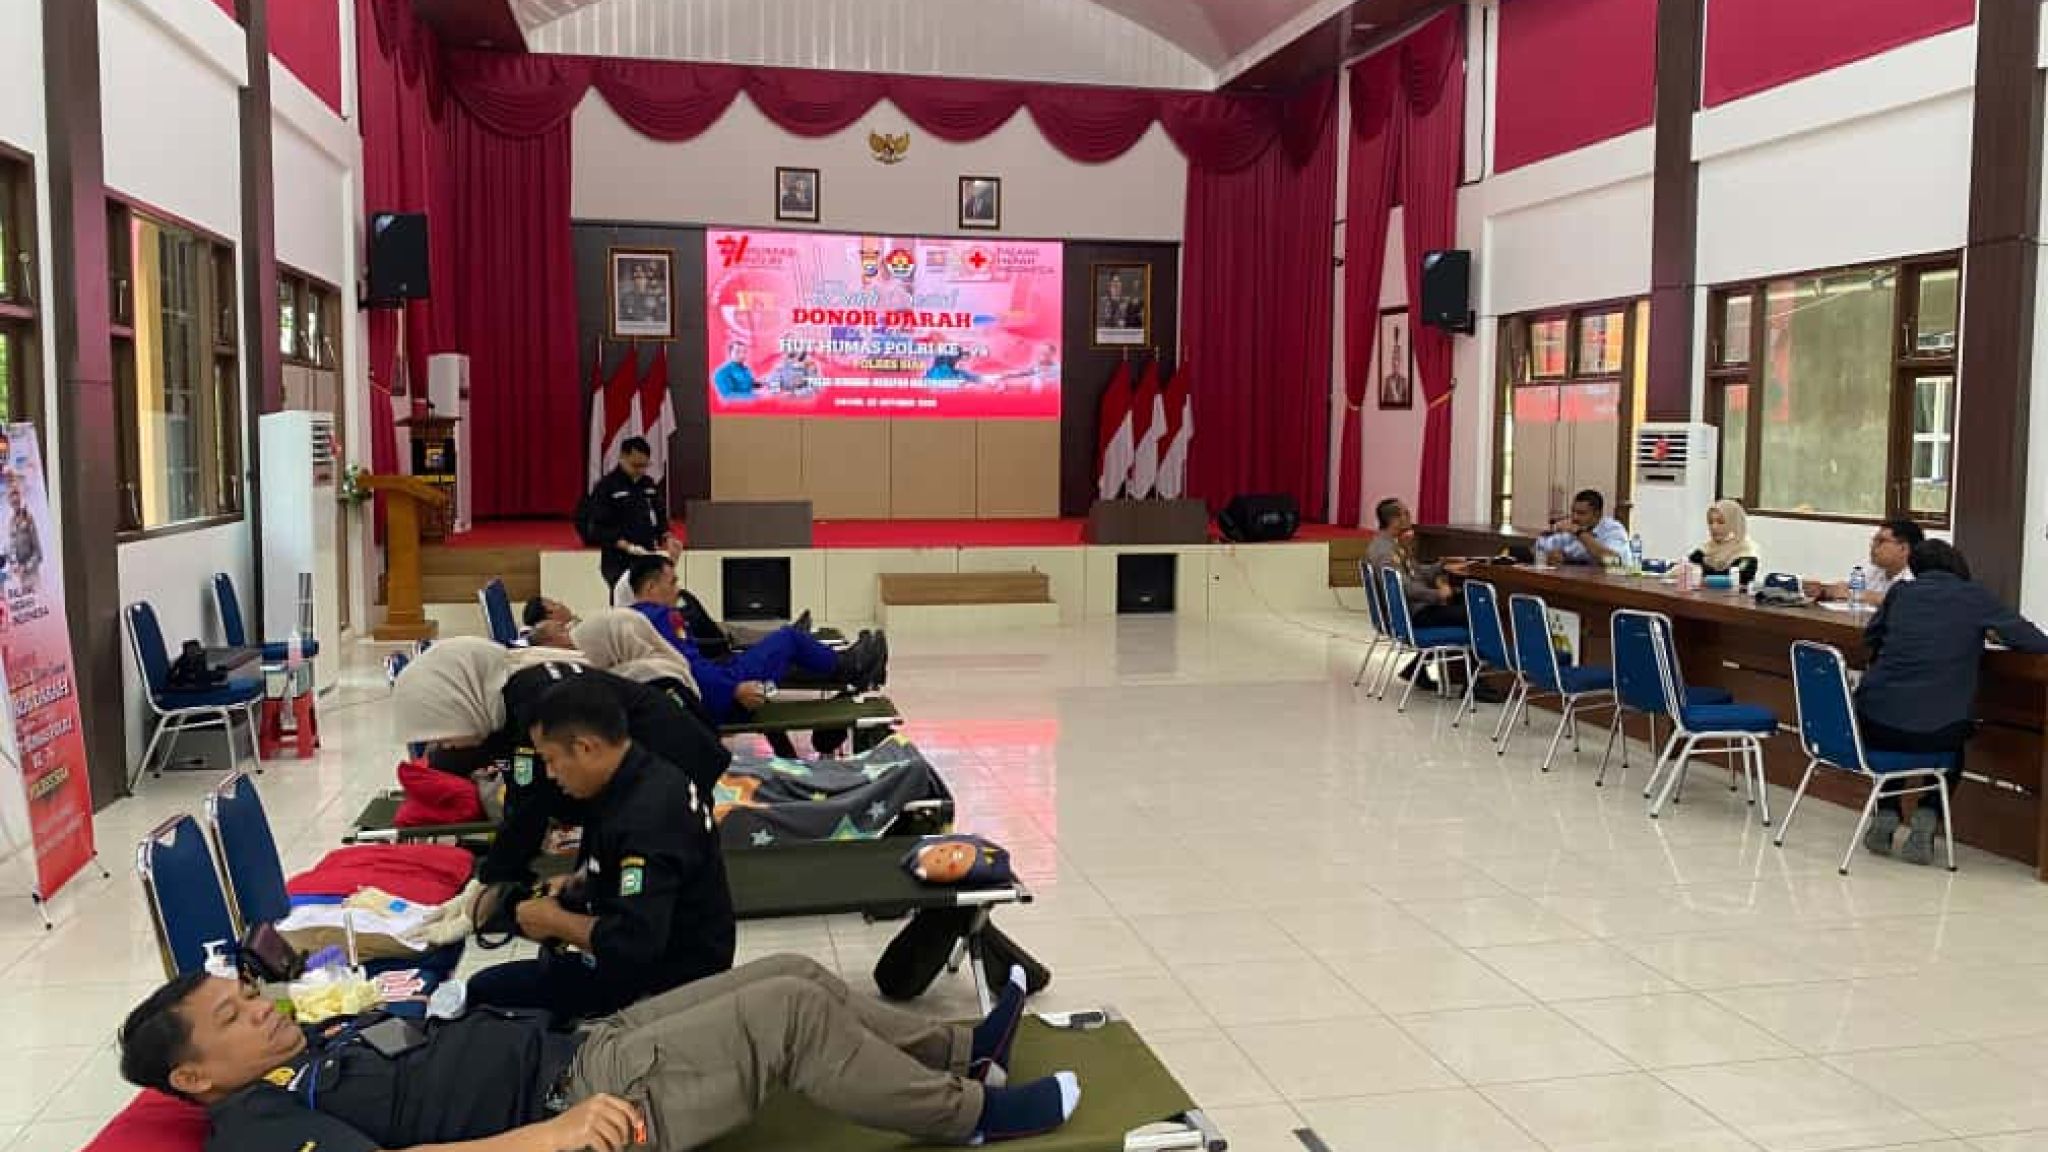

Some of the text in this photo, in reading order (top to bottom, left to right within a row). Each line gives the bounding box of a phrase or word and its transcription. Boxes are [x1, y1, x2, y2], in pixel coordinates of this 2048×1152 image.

[792, 308, 971, 328] DONOR DARAH
[819, 338, 881, 355] HUMAS
[884, 341, 935, 356] POLRI
